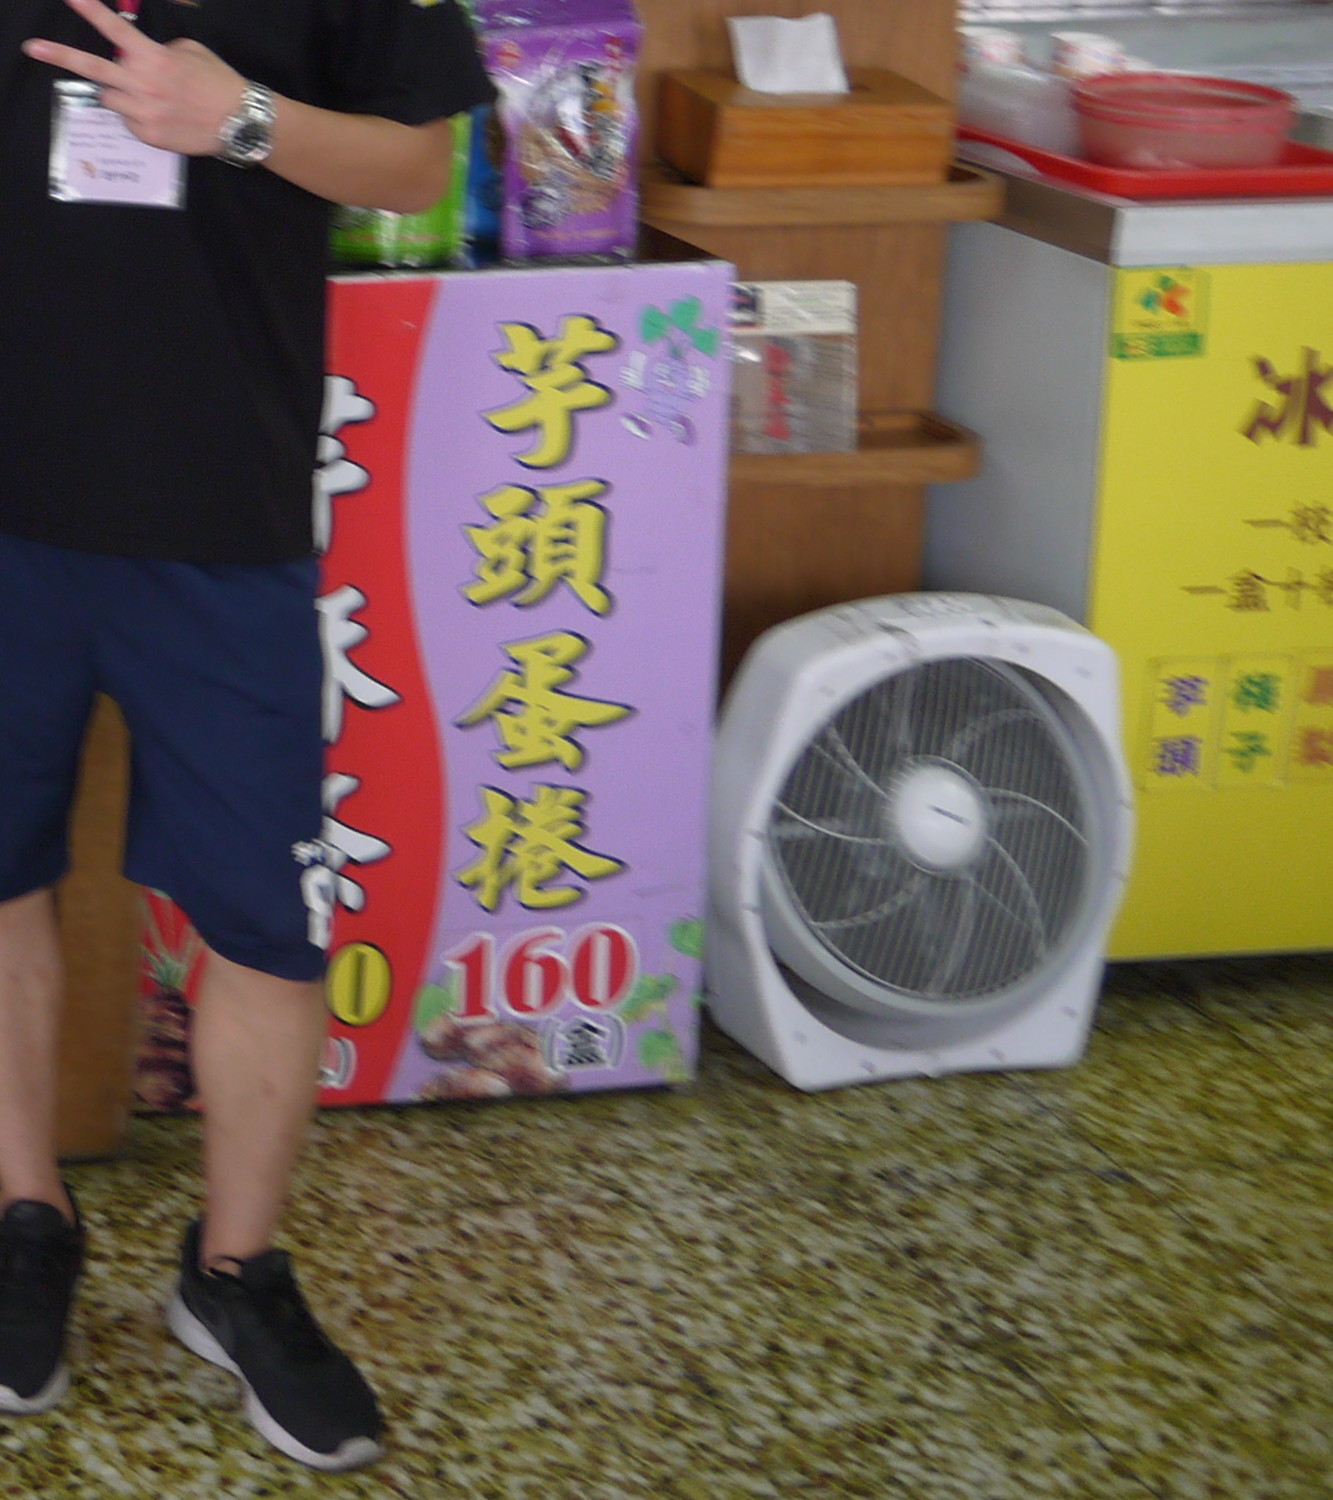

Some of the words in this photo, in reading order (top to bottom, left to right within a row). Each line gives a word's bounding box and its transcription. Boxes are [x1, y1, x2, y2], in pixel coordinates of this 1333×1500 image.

[455, 314, 635, 912] 芋頭蛋捲
[444, 924, 638, 1022] 160
